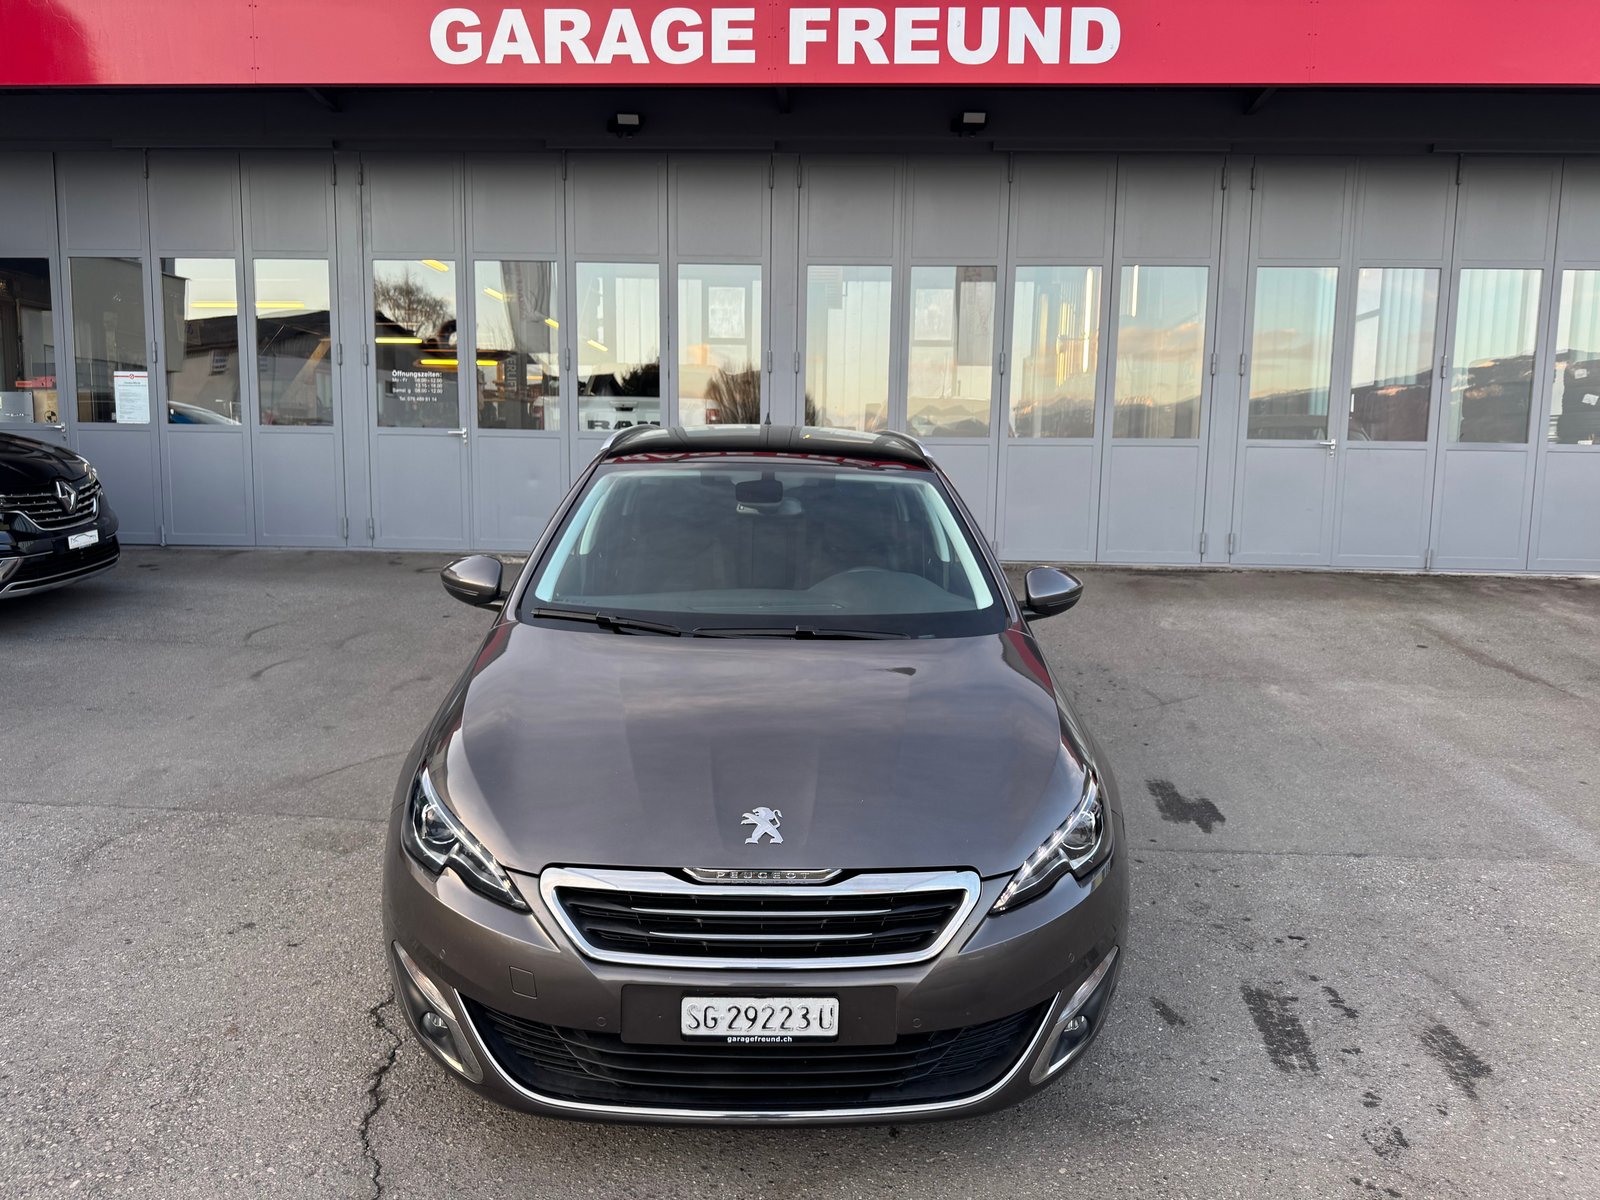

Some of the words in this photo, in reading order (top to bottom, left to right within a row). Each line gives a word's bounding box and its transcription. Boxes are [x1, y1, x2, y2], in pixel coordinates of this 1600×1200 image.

[430, 7, 756, 65] GARAGE
[789, 7, 1121, 64] FREUND
[716, 871, 810, 879] PEUGEOT
